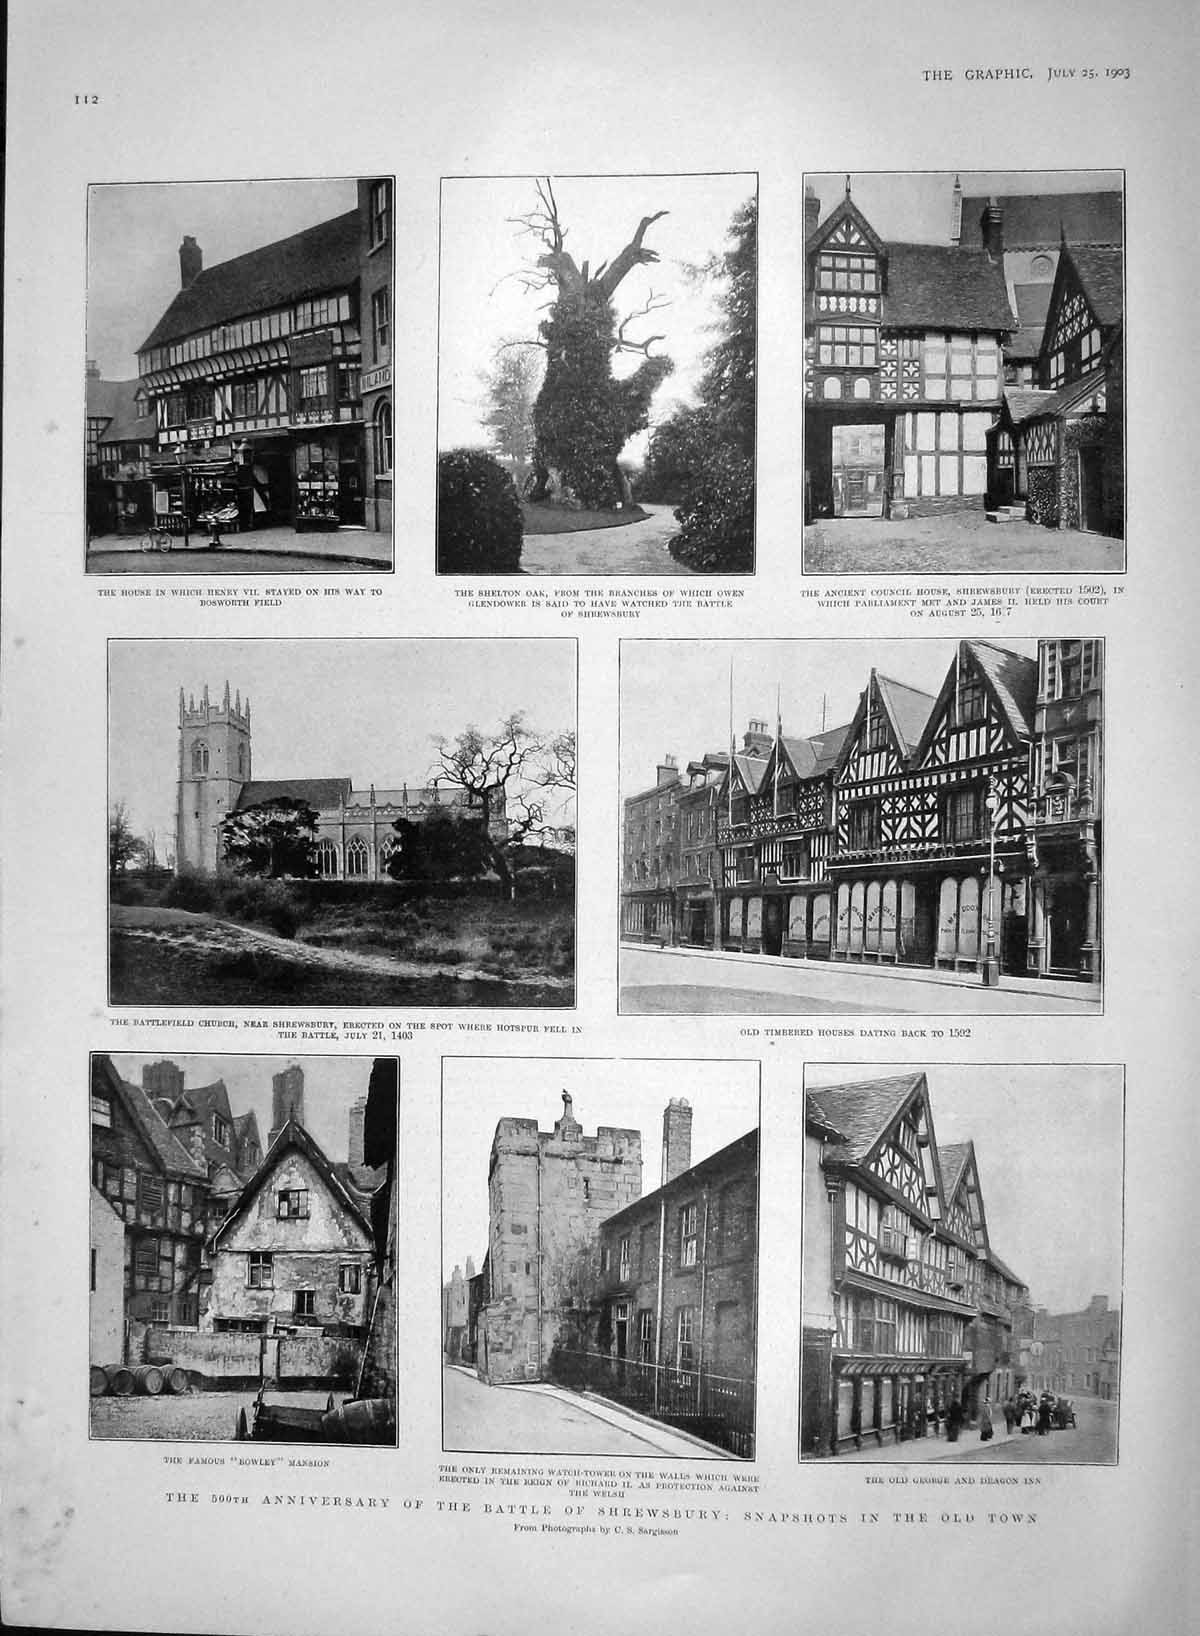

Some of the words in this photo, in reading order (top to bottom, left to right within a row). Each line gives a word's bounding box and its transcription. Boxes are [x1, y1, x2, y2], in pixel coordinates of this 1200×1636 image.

[922, 70, 952, 81] THE
[963, 67, 1032, 80] GRAPHIC,
[1048, 67, 1076, 82] JULY
[1080, 68, 1098, 79] 25,
[1104, 66, 1130, 79] 1903
[75, 96, 99, 104] 112
[97, 589, 116, 597] THE
[121, 589, 153, 597] HOUSE
[155, 589, 167, 598] IN
[206, 587, 239, 596] HENRY
[242, 588, 260, 598] VII.
[264, 588, 303, 598] STAYED
[324, 588, 340, 596] HIS
[526, 590, 548, 600] OAK,
[824, 589, 866, 598] ANCIENT
[916, 588, 952, 598] HOUSE,
[956, 587, 1020, 596] SHREWSBURY
[1024, 585, 1073, 597] (ERECTED
[1078, 585, 1106, 596] 1502),
[1112, 586, 1124, 594] IN
[200, 599, 251, 608] BOSWORTH
[532, 599, 543, 608] IS
[696, 599, 732, 607] BATTLE
[971, 598, 1003, 606] JAMES
[1024, 598, 1052, 606] HELD
[1056, 598, 1074, 606] HIS
[1078, 597, 1109, 606] COURT
[928, 609, 968, 617] AUGUST
[971, 607, 984, 617] 25,
[110, 1018, 130, 1026] THE
[133, 1019, 194, 1027] BATTLEFIELD
[198, 1020, 238, 1029] CHURCH,
[273, 1021, 337, 1031] SHREWSBURY,
[497, 1024, 541, 1032] HOTSPUR
[301, 1032, 339, 1041] BATTLE,
[344, 1032, 368, 1040] JULY
[372, 1031, 386, 1040] 21,
[392, 1031, 413, 1040] 1403
[818, 1029, 854, 1037] HOUSES
[931, 1030, 944, 1038] TO
[950, 1028, 971, 1038] 1592
[189, 1456, 225, 1465] FAMOUS
[288, 1458, 330, 1469] MANSION
[438, 1465, 457, 1474] THE
[461, 1466, 488, 1476] ONLY
[491, 1467, 544, 1477] REMAINING
[547, 1468, 617, 1479] WATCH-TOWER
[617, 1471, 632, 1479] ON
[635, 1472, 656, 1480] THE
[657, 1472, 690, 1481] WALLS
[695, 1472, 728, 1482] WHICH
[732, 1474, 759, 1484] WERE
[439, 1474, 480, 1484] ERECTED
[484, 1476, 497, 1485] IN
[500, 1476, 520, 1486] THE
[523, 1476, 554, 1488] REIGN
[556, 1477, 570, 1488] OF
[574, 1478, 620, 1489] RICHARD
[638, 1480, 650, 1489] AS
[655, 1480, 715, 1493] PROTECTION
[718, 1483, 760, 1494] AGAINST
[864, 1476, 885, 1484] THE
[889, 1476, 910, 1486] OLD
[911, 1476, 950, 1486] GEORGE
[954, 1477, 975, 1485] AND
[980, 1476, 1018, 1485] DRAGON
[1024, 1477, 1041, 1485] INN
[593, 1489, 625, 1498] WELSH
[166, 1492, 199, 1503] THE
[211, 1494, 248, 1504] 500TH
[262, 1496, 389, 1509] ANNIVERSARY
[403, 1499, 423, 1509] OF
[437, 1501, 470, 1512] THE
[483, 1504, 551, 1515] BATTLE
[565, 1506, 584, 1515] OF
[598, 1506, 728, 1520] SHREWSBURY:
[744, 1512, 847, 1525] SNAPSHOTS
[861, 1512, 879, 1523] IN
[893, 1512, 927, 1523] THE
[941, 1512, 974, 1523] OLD
[988, 1512, 1037, 1523] TOWN
[512, 1523, 538, 1533] From
[542, 1524, 598, 1536] Photographs
[599, 1525, 611, 1536] by
[613, 1526, 625, 1536] C.
[626, 1525, 635, 1536] S.
